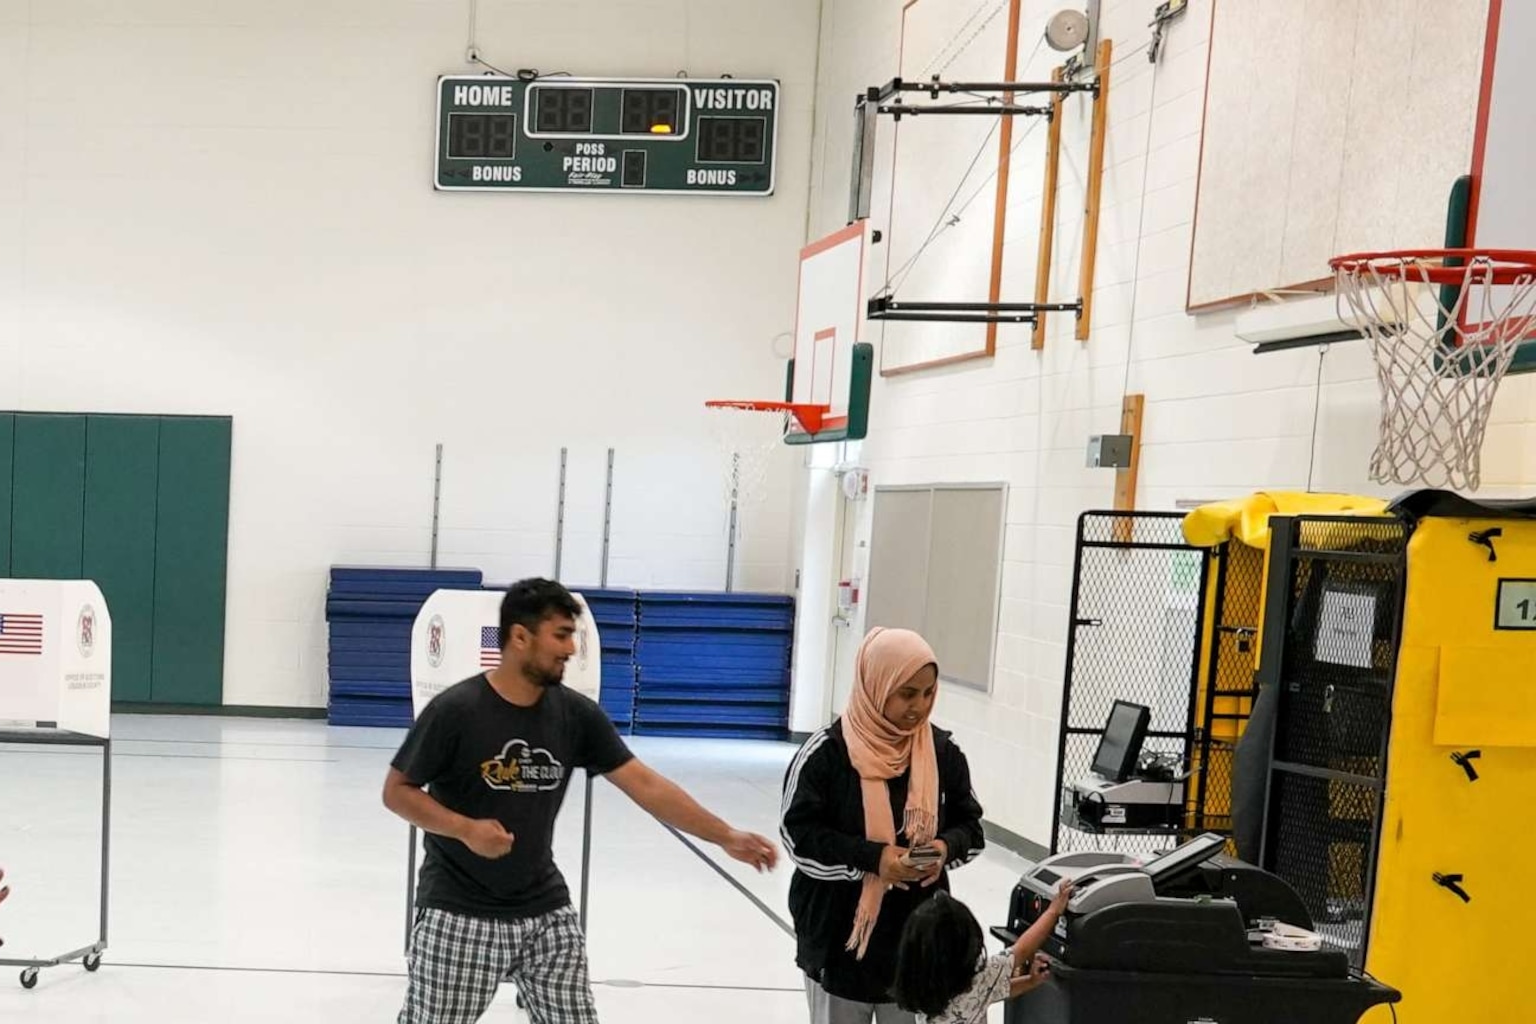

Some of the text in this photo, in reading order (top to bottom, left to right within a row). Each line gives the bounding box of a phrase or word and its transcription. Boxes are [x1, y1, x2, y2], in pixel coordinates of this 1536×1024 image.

[454, 85, 513, 107] HOME
[694, 88, 773, 110] VISITOR
[576, 143, 605, 155] POSS
[563, 156, 617, 172] PERIOD
[472, 165, 522, 182] BONUS
[686, 169, 737, 185] BONUS
[1516, 598, 1536, 621] 1
[521, 765, 540, 779] THE
